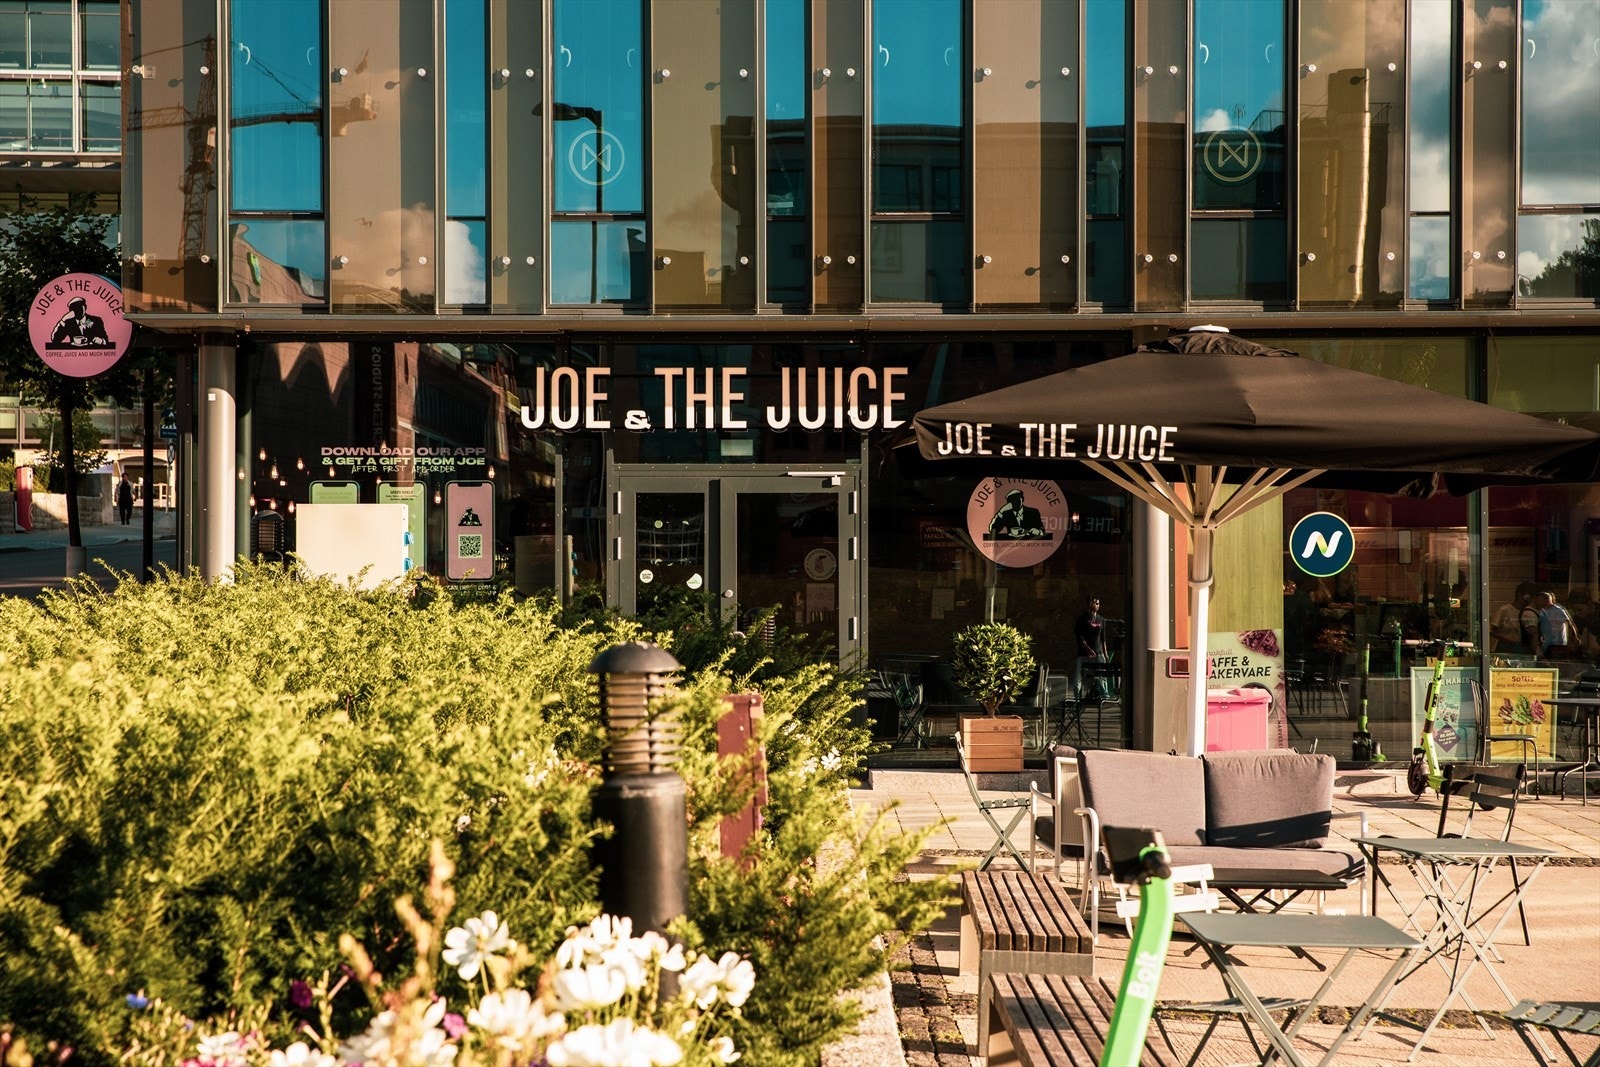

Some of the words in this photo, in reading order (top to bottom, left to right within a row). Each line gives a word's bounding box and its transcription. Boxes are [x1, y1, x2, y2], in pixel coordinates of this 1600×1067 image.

[35, 291, 56, 315] JOE
[54, 284, 65, 296] &
[66, 280, 91, 292] THE
[92, 286, 122, 315] JUICE
[520, 366, 611, 430] JOE
[624, 410, 651, 430] &
[654, 367, 747, 429] THE
[766, 366, 908, 430] JUICE
[321, 447, 414, 456] DOWNLOAD
[416, 447, 451, 456] OUR
[453, 447, 486, 456] APP
[937, 422, 993, 456] JOE
[1001, 444, 1017, 457] &
[1019, 423, 1077, 458] THE
[1087, 423, 1178, 462] JUICE
[321, 457, 333, 465] &
[335, 457, 364, 465] GET
[366, 457, 377, 465] A
[379, 457, 411, 465] GIFT
[414, 457, 455, 465] FROM
[456, 457, 486, 465] JOE
[351, 465, 378, 474] AFTER
[975, 484, 994, 507] JOE
[993, 478, 1003, 488] &
[1031, 480, 1061, 507] JUICE
[1209, 666, 1272, 679] AKERVARE
[1211, 656, 1238, 668] AFFE
[1241, 656, 1250, 666] &
[1126, 950, 1163, 1000] Bolt
